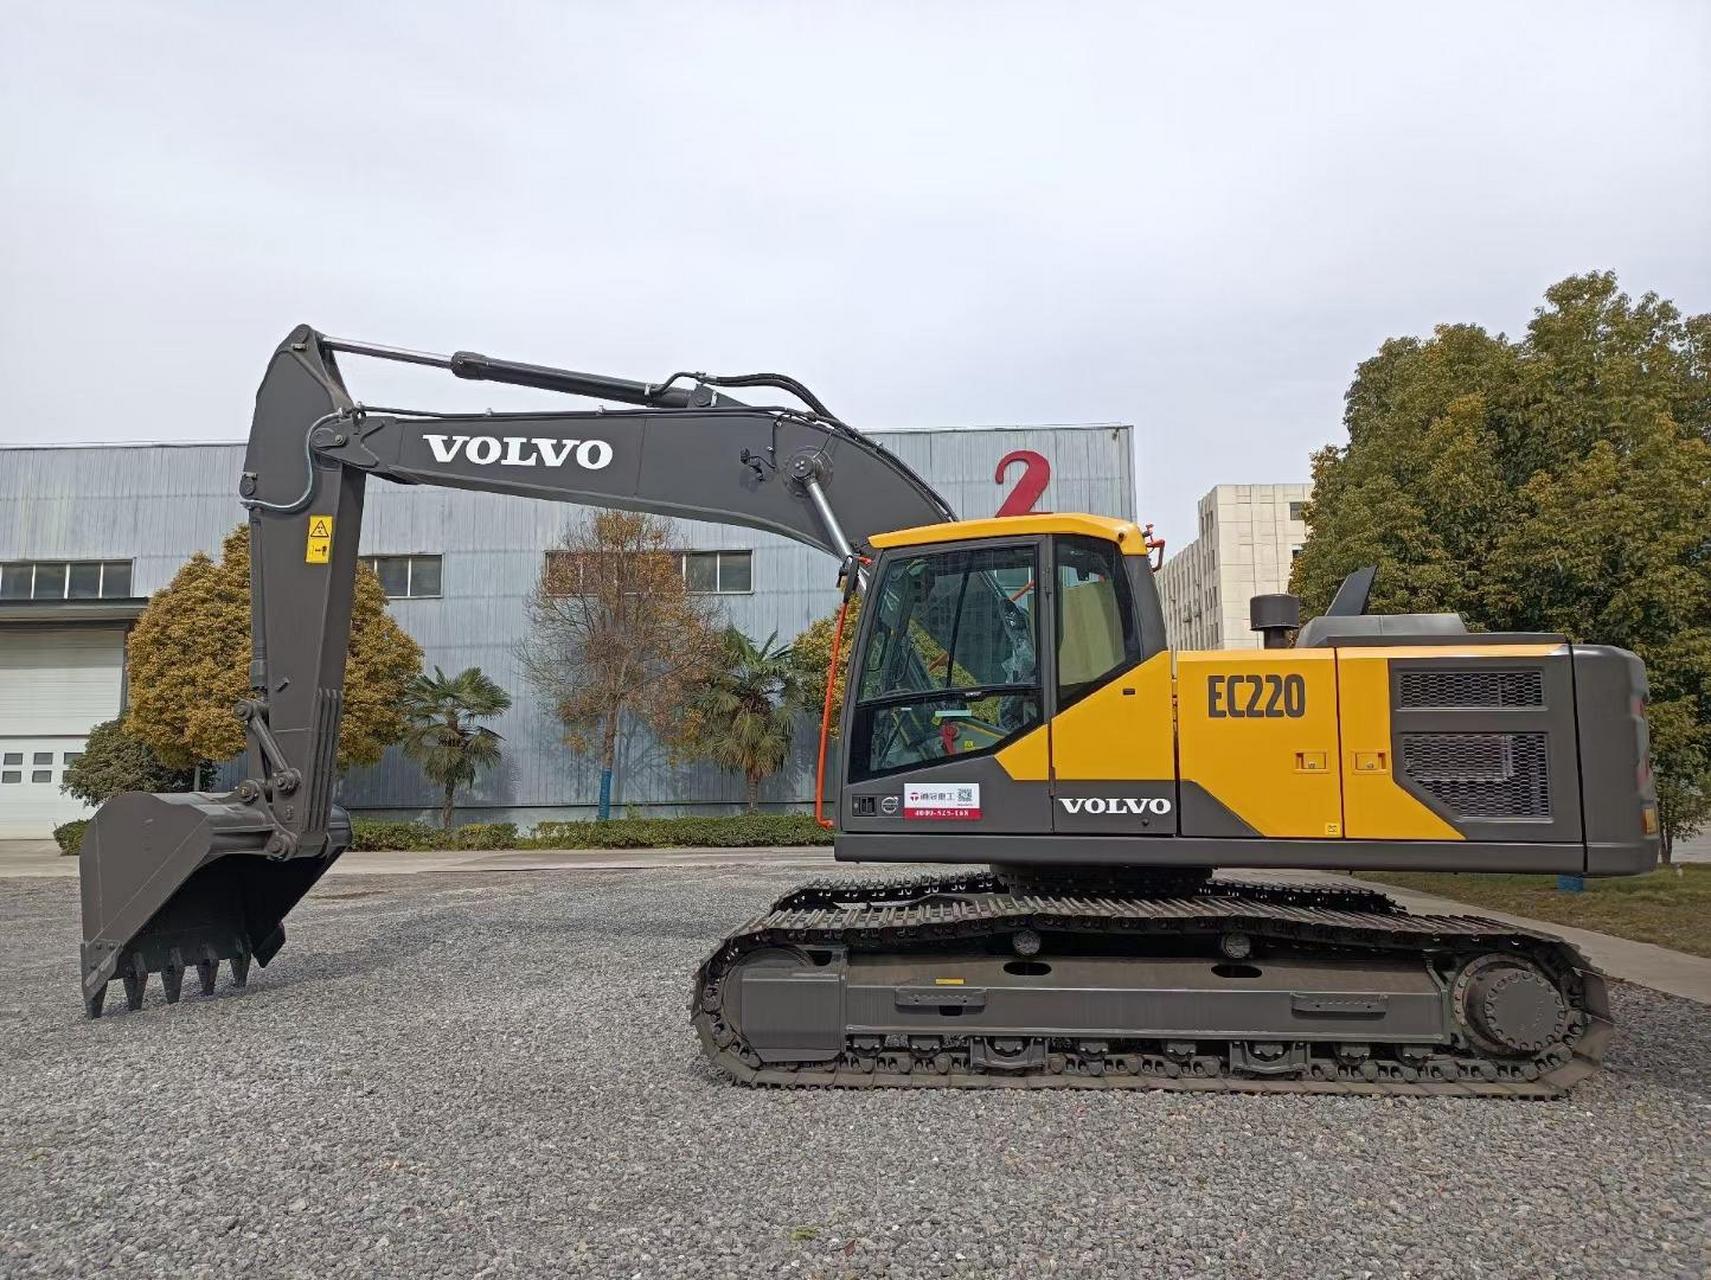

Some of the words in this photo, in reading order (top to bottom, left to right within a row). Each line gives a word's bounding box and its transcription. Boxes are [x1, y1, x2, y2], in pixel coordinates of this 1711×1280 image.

[422, 434, 613, 470] VOLVO
[995, 450, 1052, 517] 2
[1207, 674, 1306, 718] EC220
[1058, 797, 1171, 815] VOLVO
